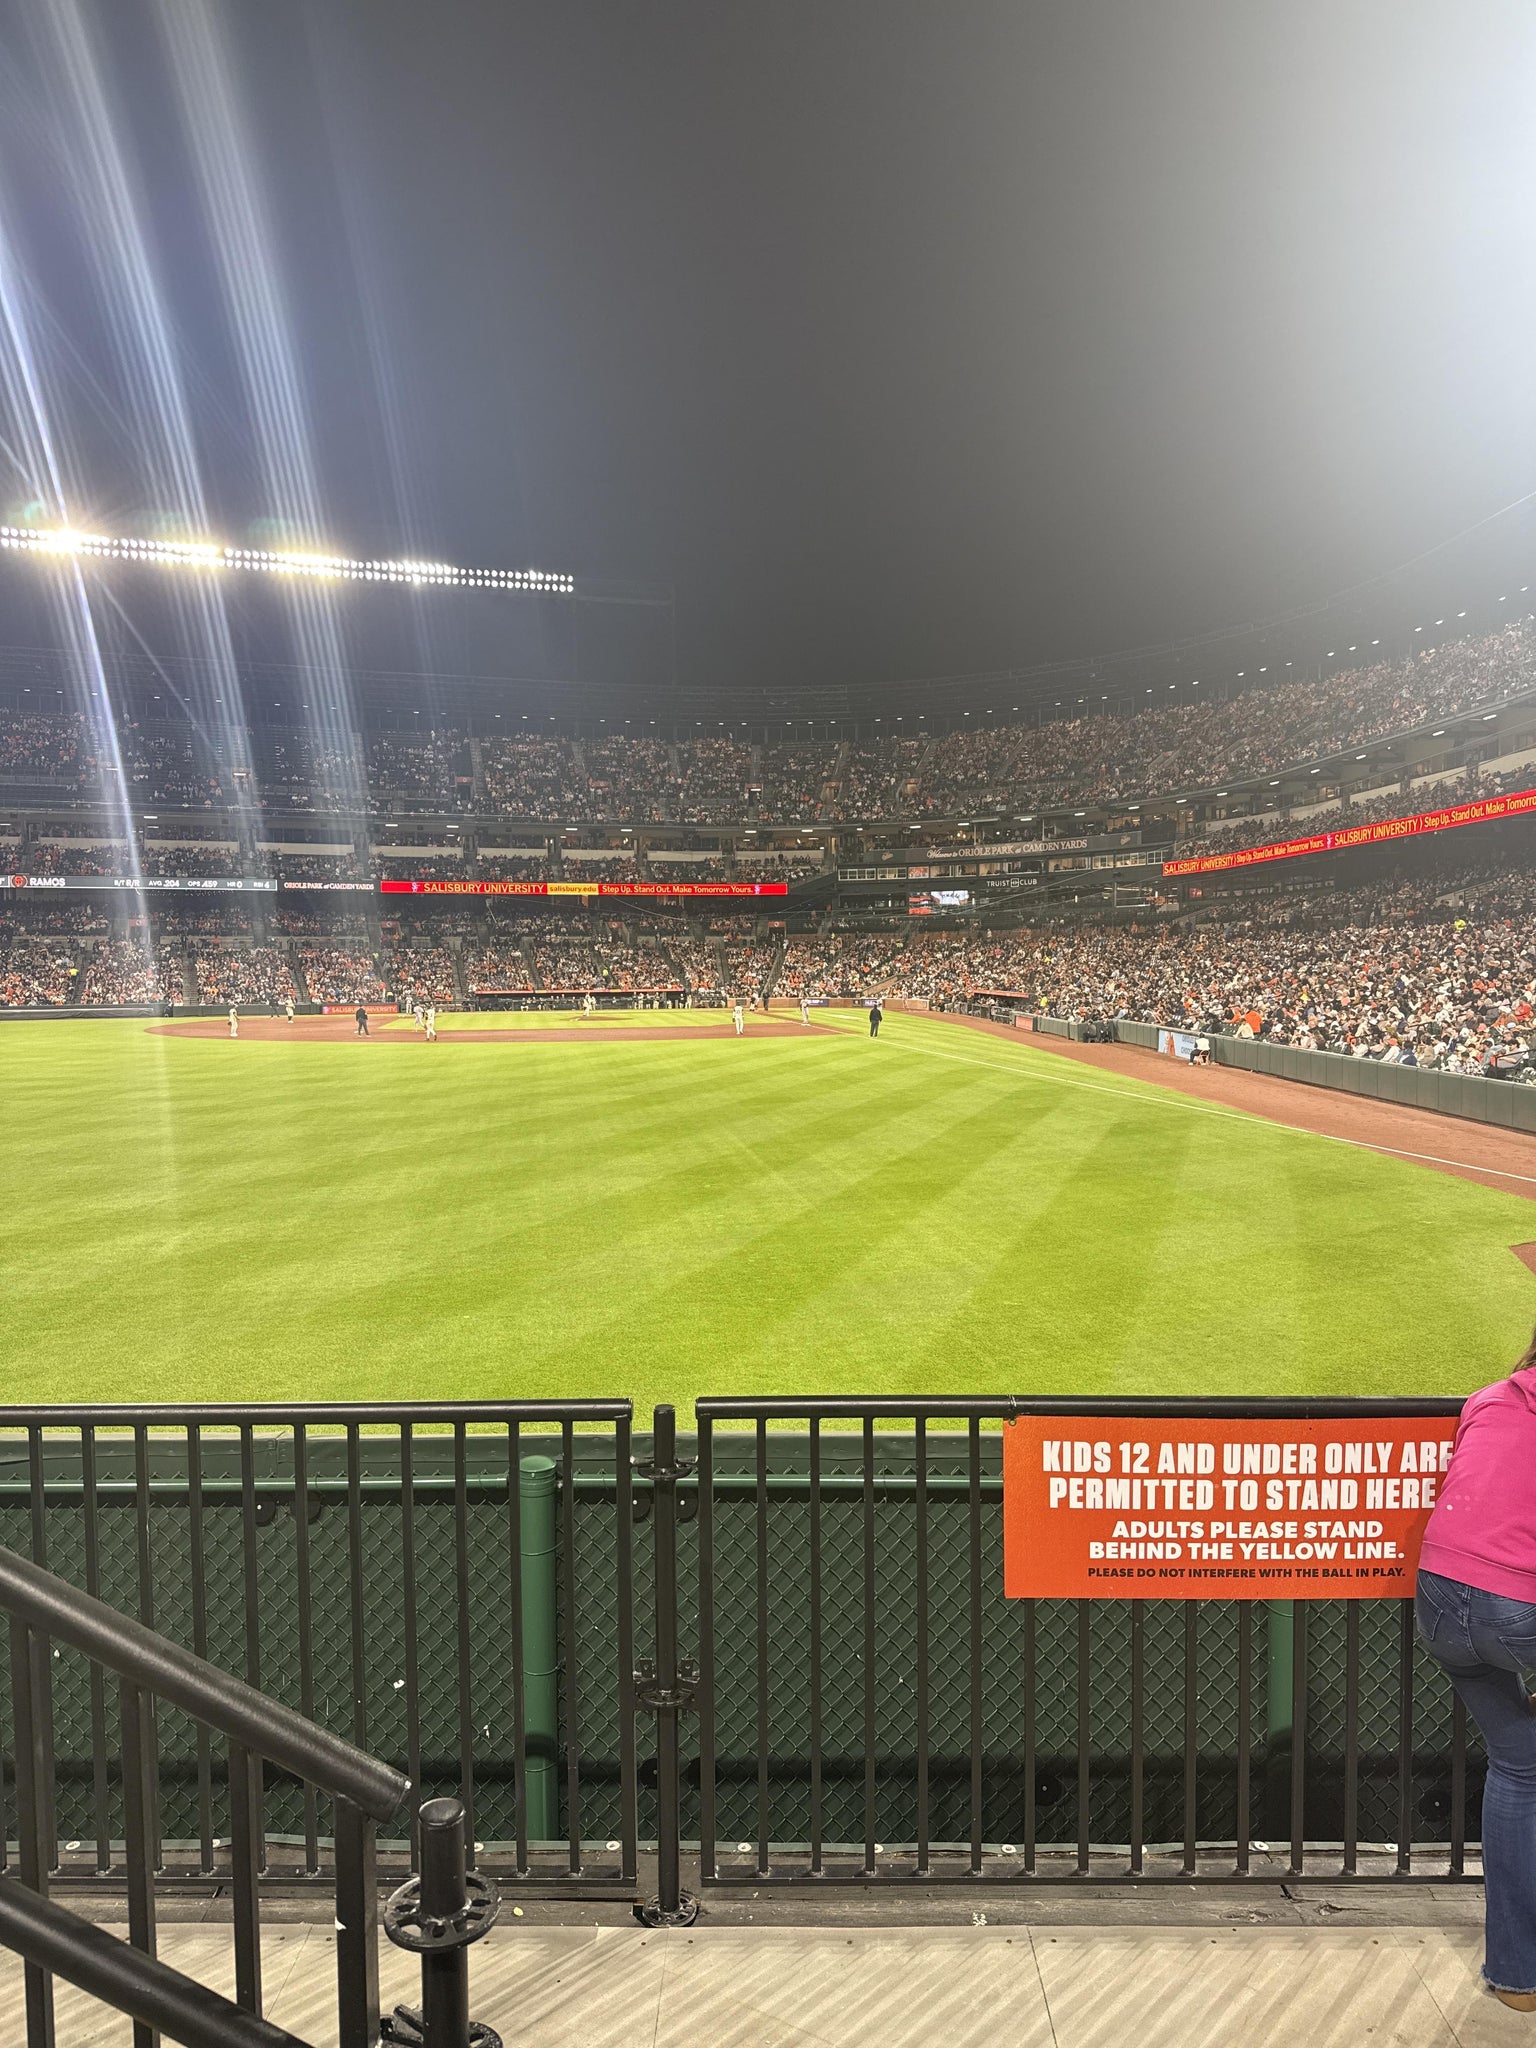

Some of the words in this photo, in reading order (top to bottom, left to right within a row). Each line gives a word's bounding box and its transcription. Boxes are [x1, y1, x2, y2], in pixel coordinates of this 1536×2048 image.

[1424, 816, 1439, 828] Step
[1440, 814, 1450, 826] Up.
[1451, 809, 1470, 822] Stand
[1470, 806, 1484, 818] Out.
[1486, 802, 1504, 815] Make
[1334, 828, 1373, 846] SALISBURY
[1373, 820, 1418, 838] UNIVERSITY
[958, 846, 991, 858] ORIOLE
[991, 845, 1014, 856] PARK
[1022, 842, 1059, 854] CAMDEN
[1060, 839, 1088, 850] YARDS
[1164, 862, 1200, 874] SALISBURY
[1200, 856, 1234, 870] UNIVERSITY
[1236, 854, 1246, 864] Step
[1252, 850, 1265, 860] Stand
[1274, 846, 1286, 856] Make
[1286, 843, 1309, 854] Tomorrow
[30, 878, 66, 886] RAMOS
[188, 880, 201, 888] OPS
[330, 882, 354, 890] CAMDEN
[424, 883, 482, 892] SALISBURY
[483, 884, 544, 893] UNIVERSITY
[549, 886, 597, 894] salisbury.edu
[602, 884, 620, 894] Step
[620, 884, 633, 894] Up.
[634, 884, 655, 893] Stand
[656, 885, 672, 894] Out.
[672, 885, 692, 894] Make
[693, 885, 730, 894] Tomorrow
[730, 885, 754, 894] Yours.
[986, 880, 1010, 888] TRUIST
[1019, 878, 1038, 886] CLUB
[1042, 1441, 1112, 1473] KIDS
[1119, 1442, 1149, 1473] 12
[1157, 1442, 1215, 1474] AND
[1223, 1442, 1317, 1474] UNDER
[1324, 1442, 1394, 1474] ONLY
[1400, 1441, 1454, 1473] ARE
[1050, 1477, 1214, 1509] PERMITTED
[1221, 1480, 1258, 1512] TO
[1265, 1478, 1358, 1510] STAND
[1366, 1478, 1436, 1510] HERE
[1112, 1520, 1204, 1539] ADULTS
[1210, 1520, 1298, 1539] PLEASE
[1304, 1520, 1383, 1539] STAND
[1089, 1542, 1182, 1560] BEHIND
[1188, 1542, 1233, 1560] THE
[1239, 1542, 1339, 1560] YELLOW
[1344, 1542, 1405, 1560] LINE.
[1088, 1567, 1134, 1578] PLEASE
[1136, 1567, 1154, 1578] DO
[1156, 1567, 1186, 1578] NOT
[1188, 1567, 1256, 1578] INTERFERE
[1258, 1567, 1292, 1578] WITH
[1294, 1567, 1319, 1578] THE
[1322, 1567, 1352, 1578] BALL
[1355, 1567, 1369, 1578] IN
[1372, 1567, 1406, 1578] PLAY.
